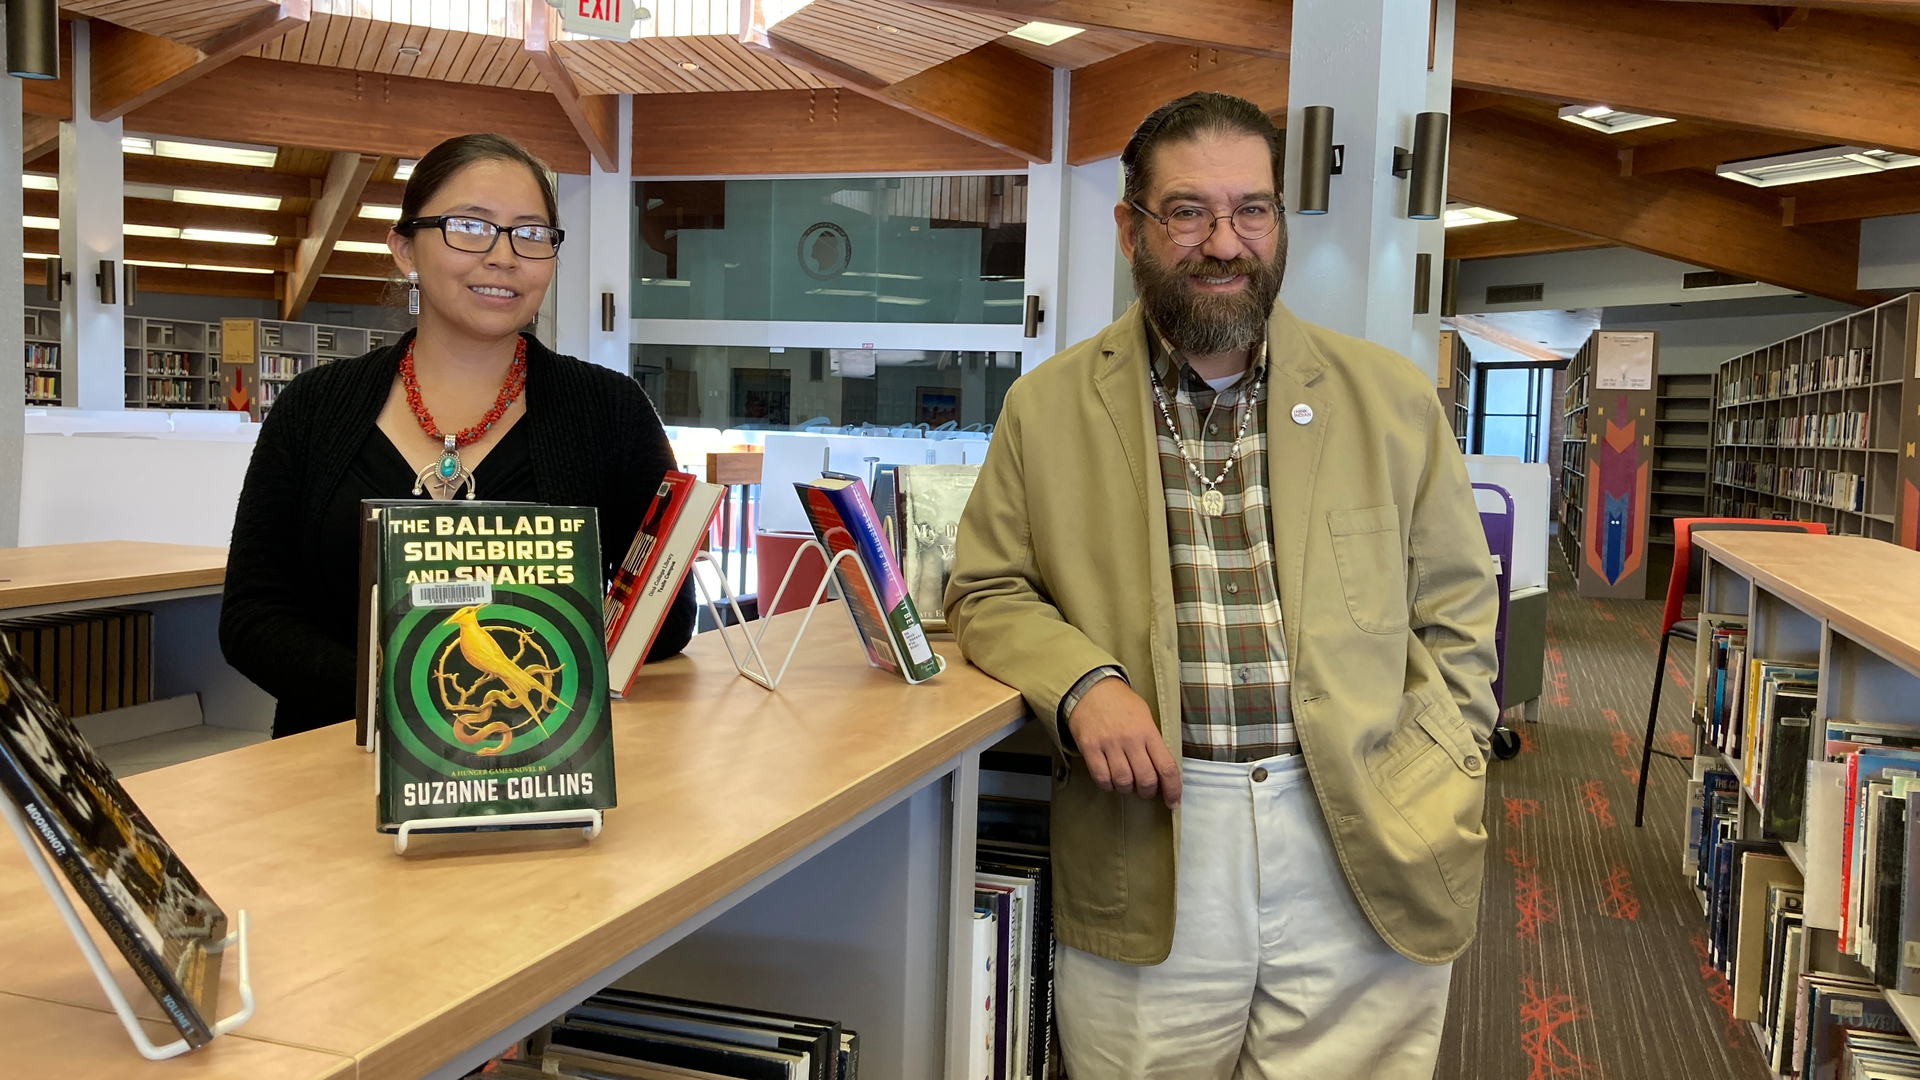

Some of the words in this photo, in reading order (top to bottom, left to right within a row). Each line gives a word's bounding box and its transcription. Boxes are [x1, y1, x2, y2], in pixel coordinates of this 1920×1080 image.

[579, 0, 620, 23] EXIT
[389, 519, 430, 534] THE
[435, 515, 555, 536] BALLAD
[560, 518, 585, 532] OF
[404, 540, 575, 562] SONGBIRDS
[405, 569, 449, 584] AND
[454, 564, 575, 585] SNAKES
[654, 569, 666, 586] College
[662, 553, 674, 568] Library
[457, 768, 488, 776] HUNGER
[489, 767, 513, 775] GAMES
[514, 766, 537, 774] NOVEL
[404, 778, 499, 807] SUZANNE
[507, 772, 593, 800] COLLINS
[163, 995, 190, 1029] VOLUME
